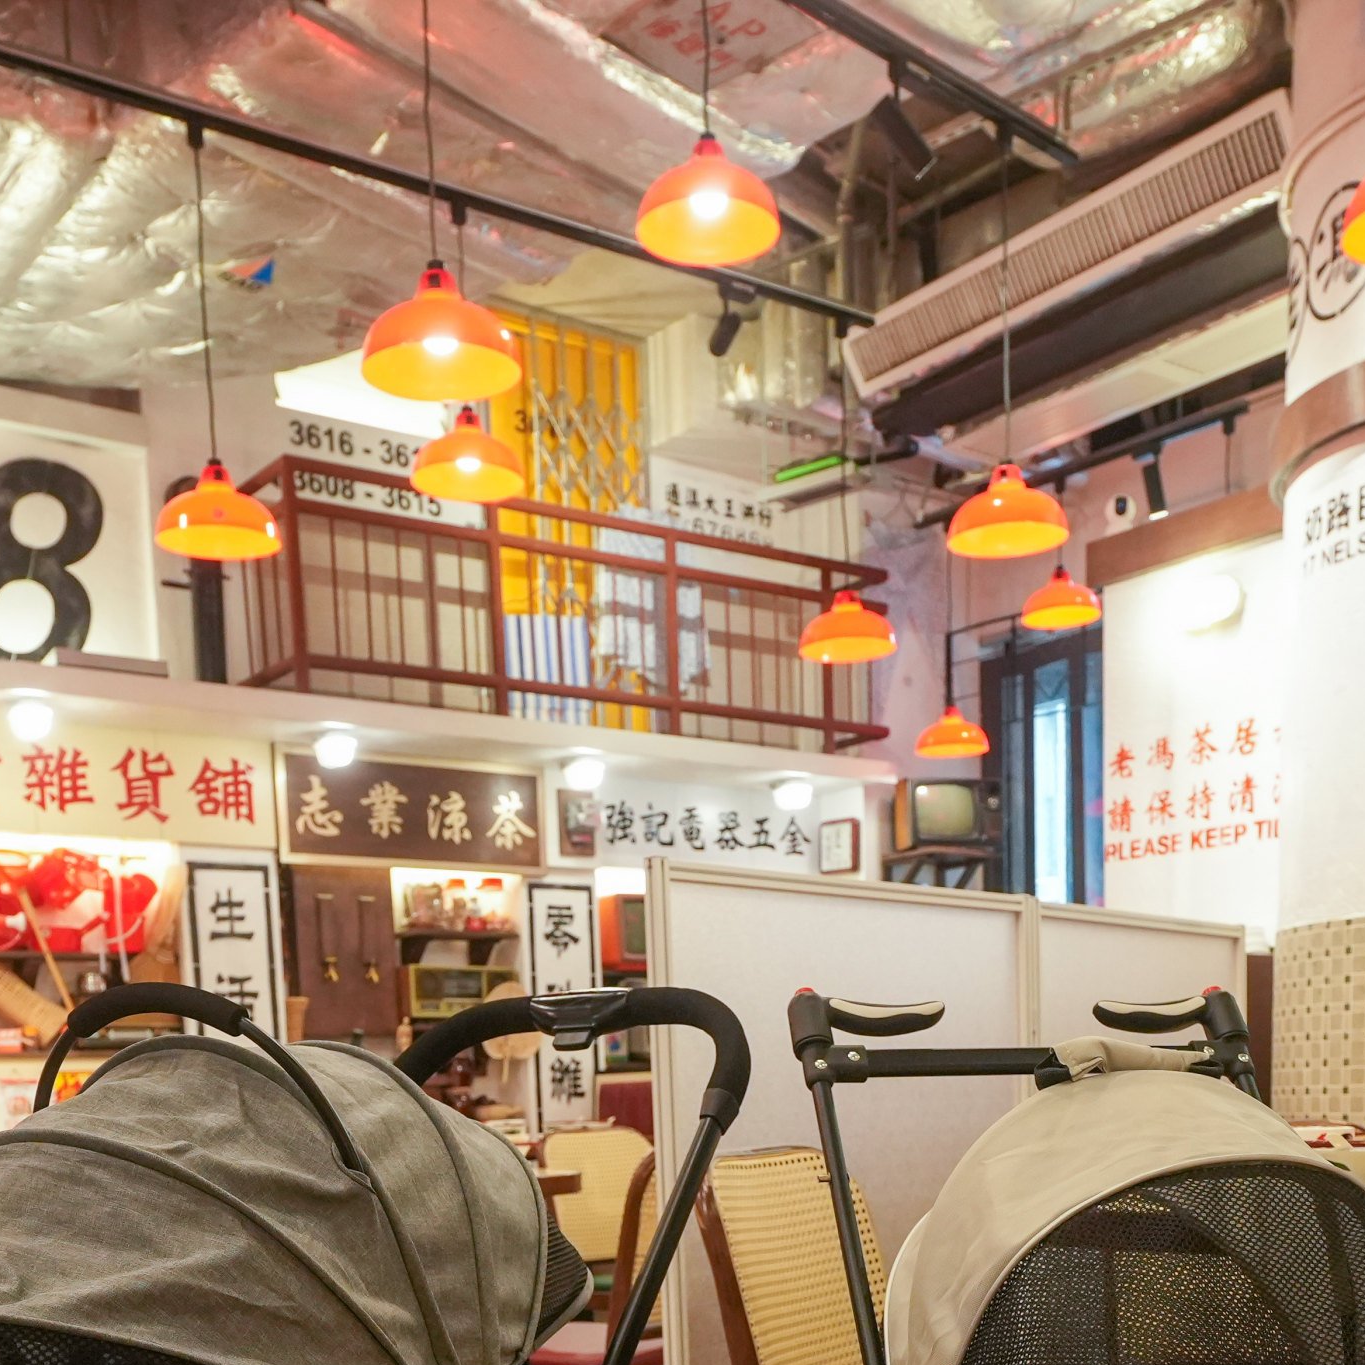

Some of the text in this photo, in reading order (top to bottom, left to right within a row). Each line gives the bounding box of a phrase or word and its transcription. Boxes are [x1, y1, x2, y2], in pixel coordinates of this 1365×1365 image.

[288, 419, 354, 457] 3616
[293, 470, 355, 500] 3608
[1109, 717, 1281, 779] 老馮茶居
[603, 799, 812, 856] 強記電器五金
[1104, 833, 1183, 863] PLEASE
[1189, 824, 1247, 850] KEEP
